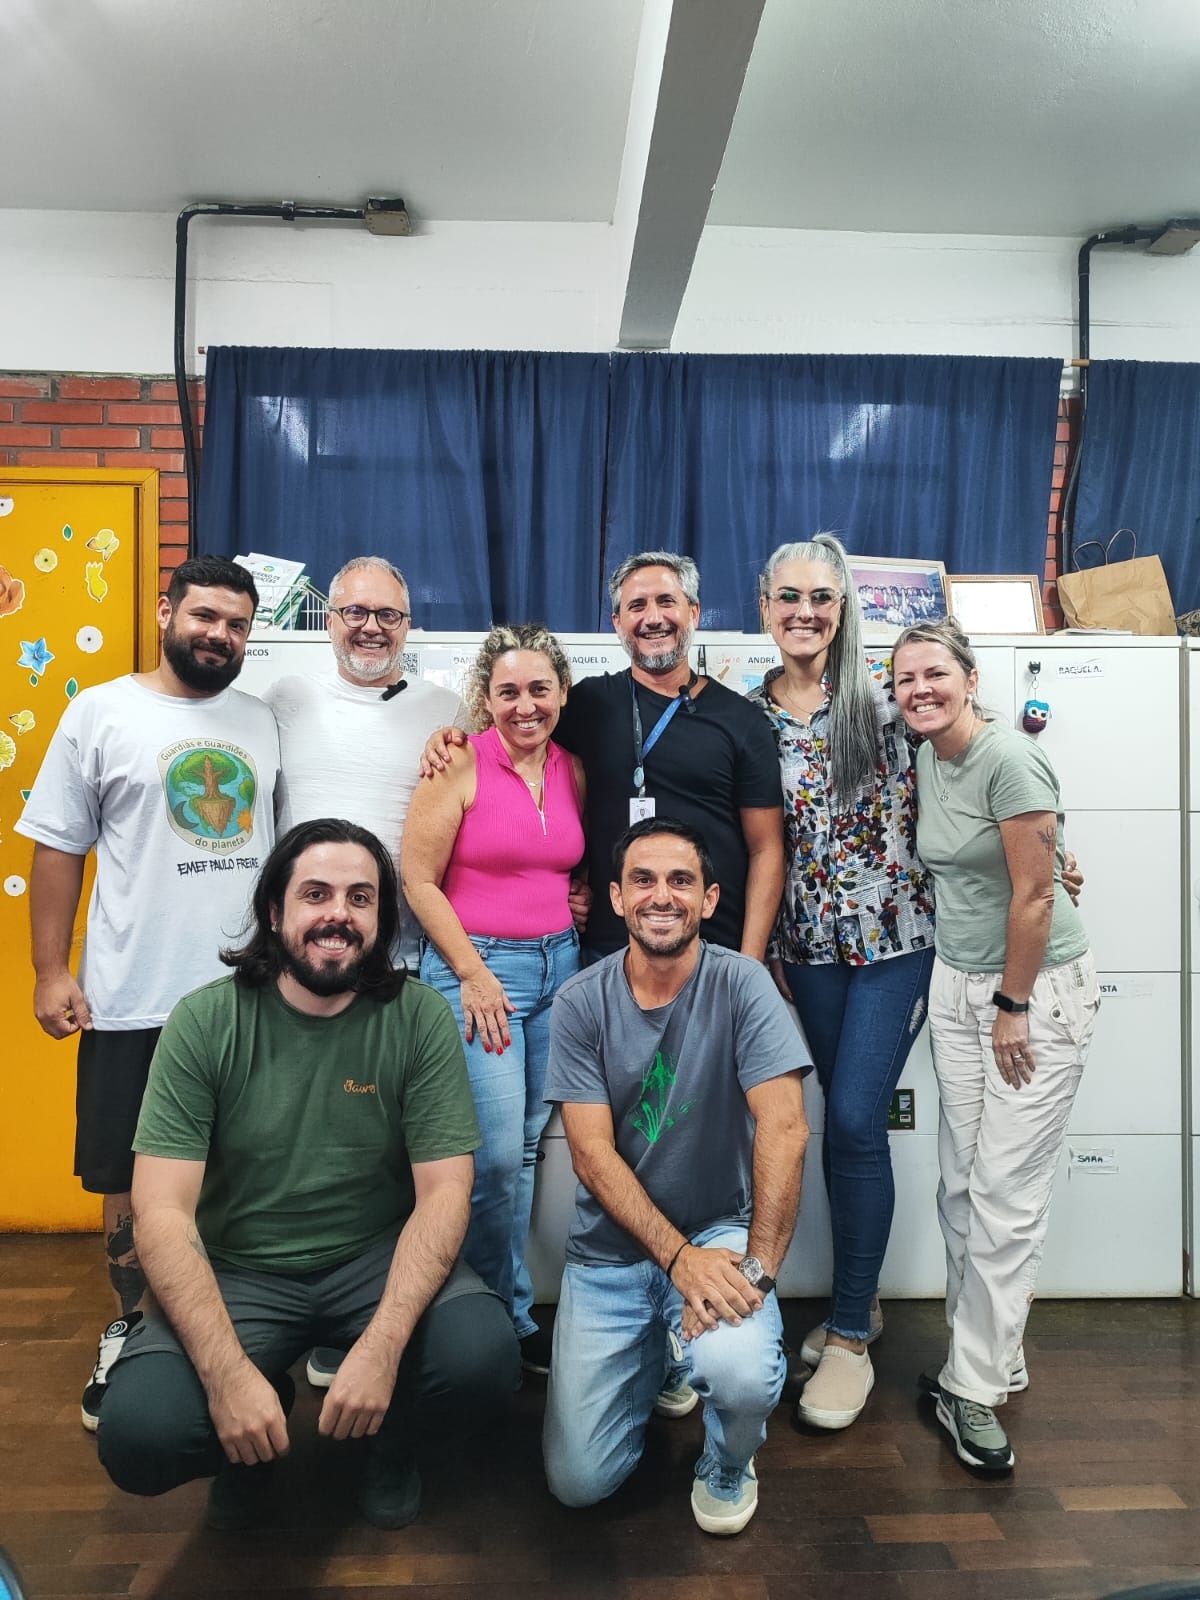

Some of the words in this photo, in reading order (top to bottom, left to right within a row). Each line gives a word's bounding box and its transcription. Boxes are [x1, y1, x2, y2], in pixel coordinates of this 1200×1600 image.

[748, 655, 776, 664] ANDRÉ
[194, 837, 208, 847] do
[211, 837, 245, 850] planeta
[177, 861, 208, 875] EMEF
[209, 858, 235, 873] PAULO
